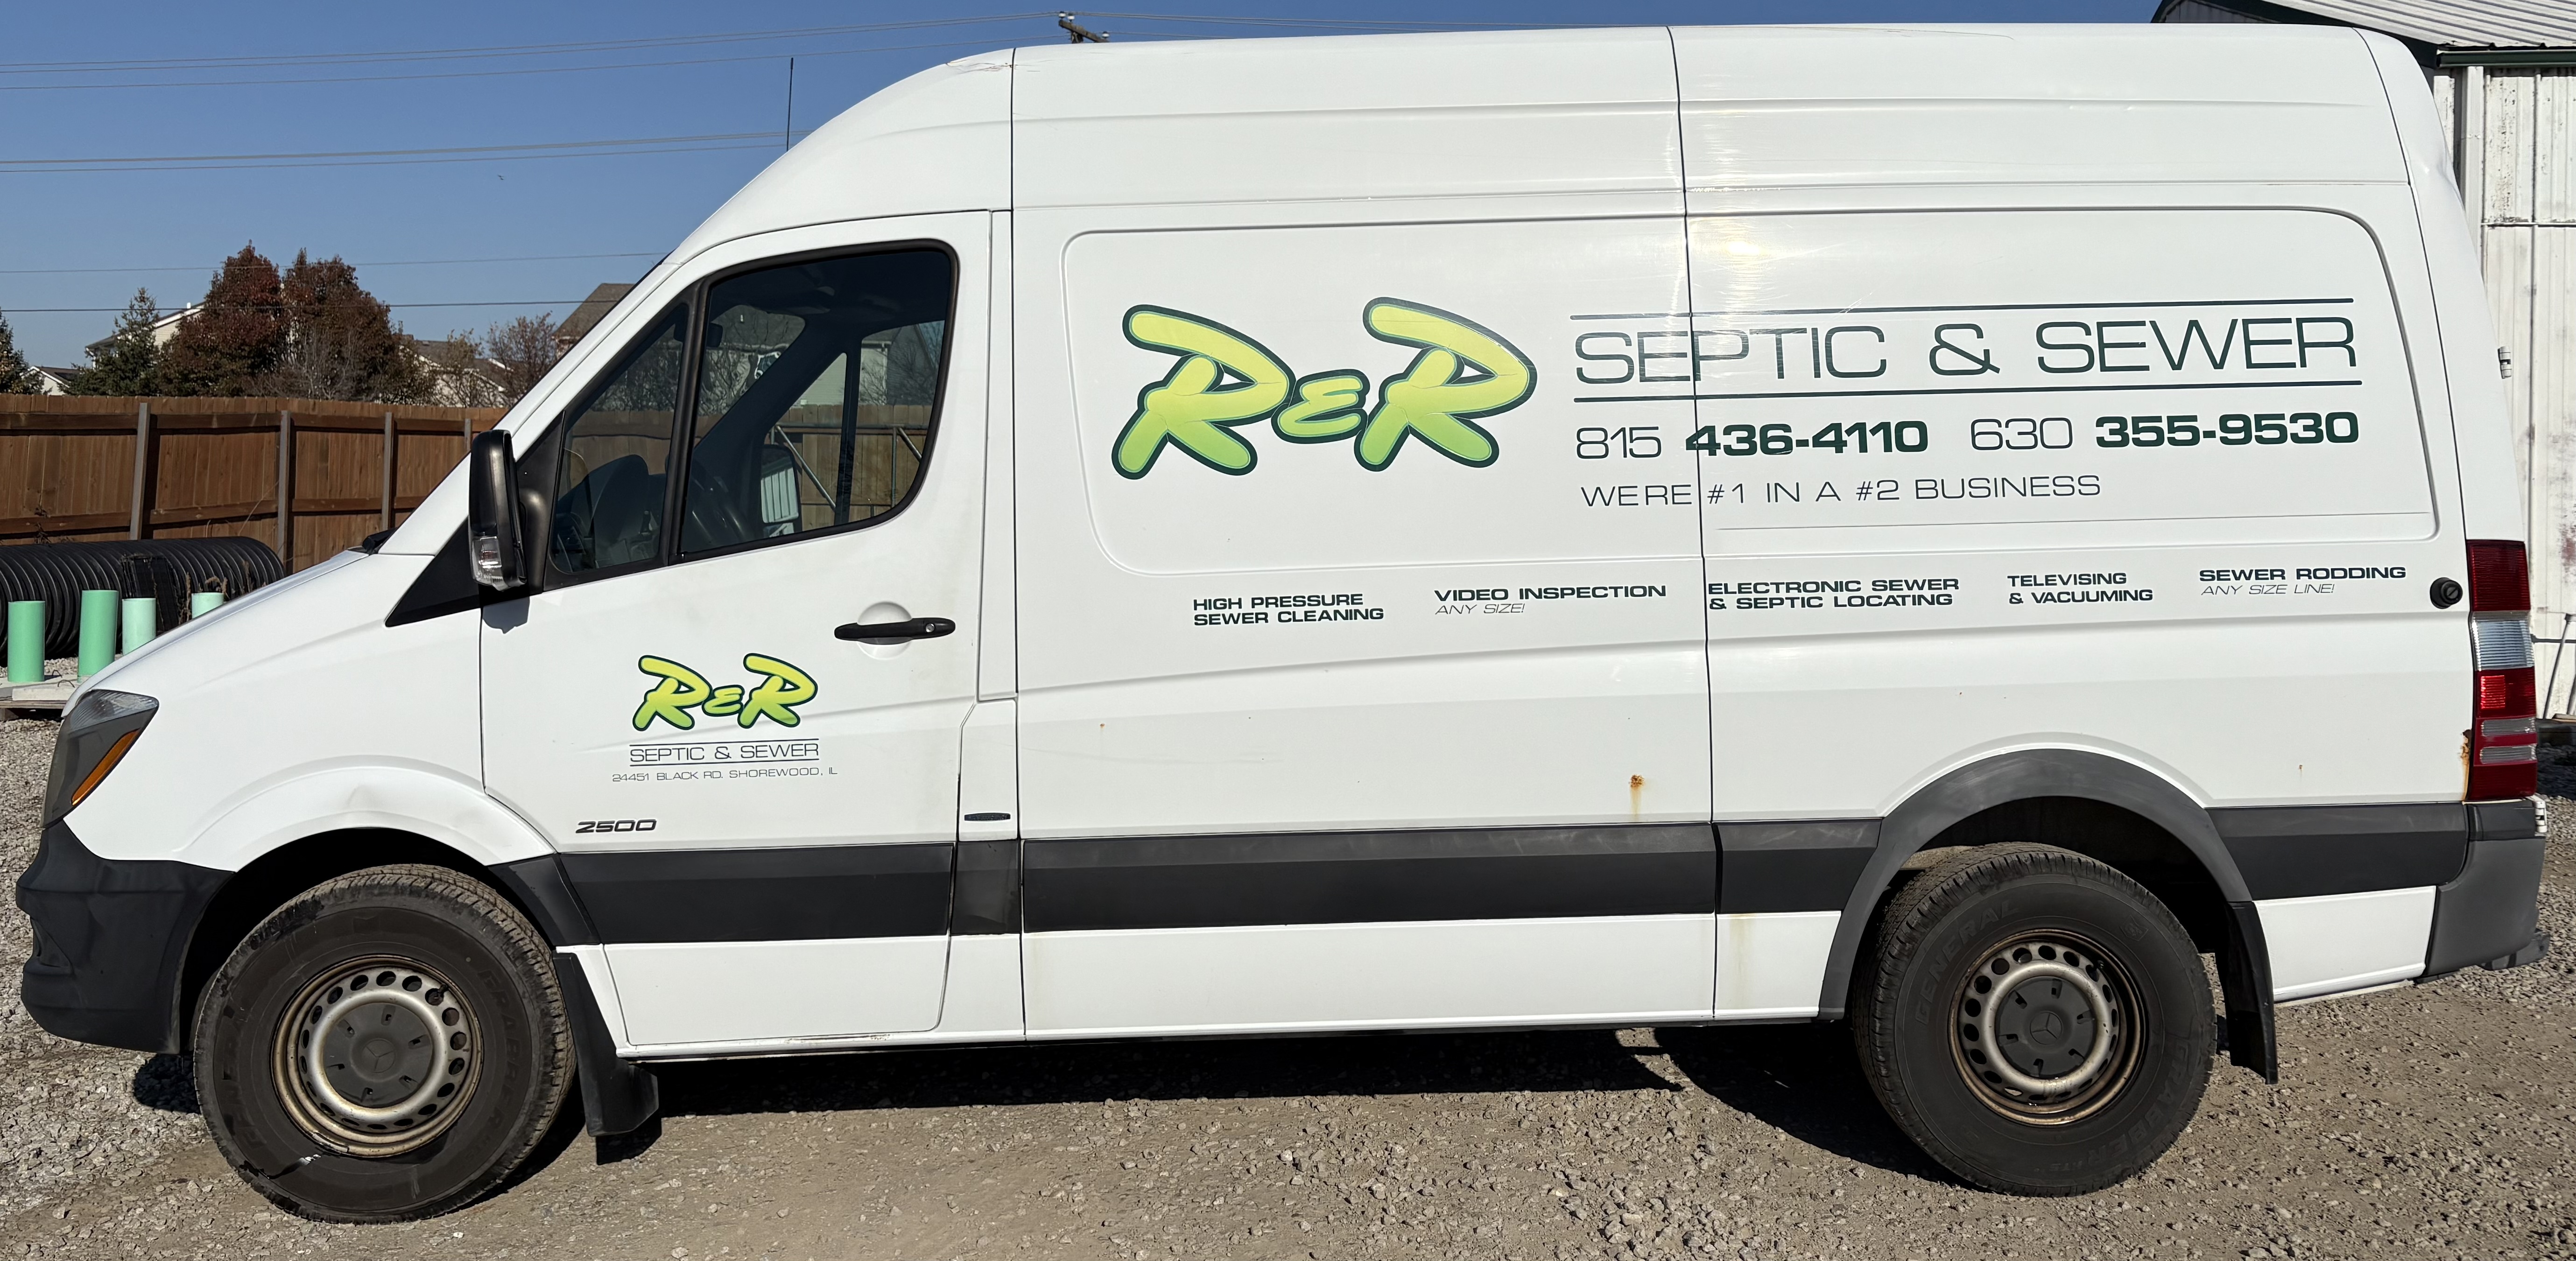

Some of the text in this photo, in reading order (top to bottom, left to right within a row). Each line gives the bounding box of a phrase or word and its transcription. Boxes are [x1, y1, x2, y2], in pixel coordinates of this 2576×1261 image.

[1575, 316, 2357, 384] SEPTIC & SEWER
[1576, 412, 2359, 459] 815 436-4110 630 355-9530
[1707, 483, 1744, 504] #1
[1767, 482, 1800, 503] IN
[1815, 481, 1841, 502] A
[1856, 479, 1900, 501] #2
[1915, 475, 2100, 499] BUSINESS
[2007, 572, 2127, 587] TELEVISING
[2199, 567, 2406, 581] SEWER RODDING
[1434, 585, 1666, 602] VIDEO INSPECTION
[1708, 578, 1959, 595] ELECTRONIC SEWER
[2201, 583, 2335, 595] ANY SIZE LINE!
[1193, 593, 1364, 611] HIGH PRESSURE
[1709, 593, 1953, 610] & SEPTIC LOCATING
[2009, 589, 2153, 604] & VACUUMING
[1193, 607, 1384, 626] SEWER CLEANING
[1435, 603, 1525, 615] ANY SIZE!
[629, 743, 820, 763] SEPTIC & SEWER
[612, 773, 649, 782] 24451
[656, 771, 699, 781] BLACK
[704, 771, 724, 779] RD.
[729, 767, 823, 778] SHOREWOOD,
[575, 819, 657, 834] 2500
[1914, 899, 2020, 1026] GENERAL
[476, 969, 521, 1128] GRABBER
[2087, 1039, 2190, 1165] GRABBER
